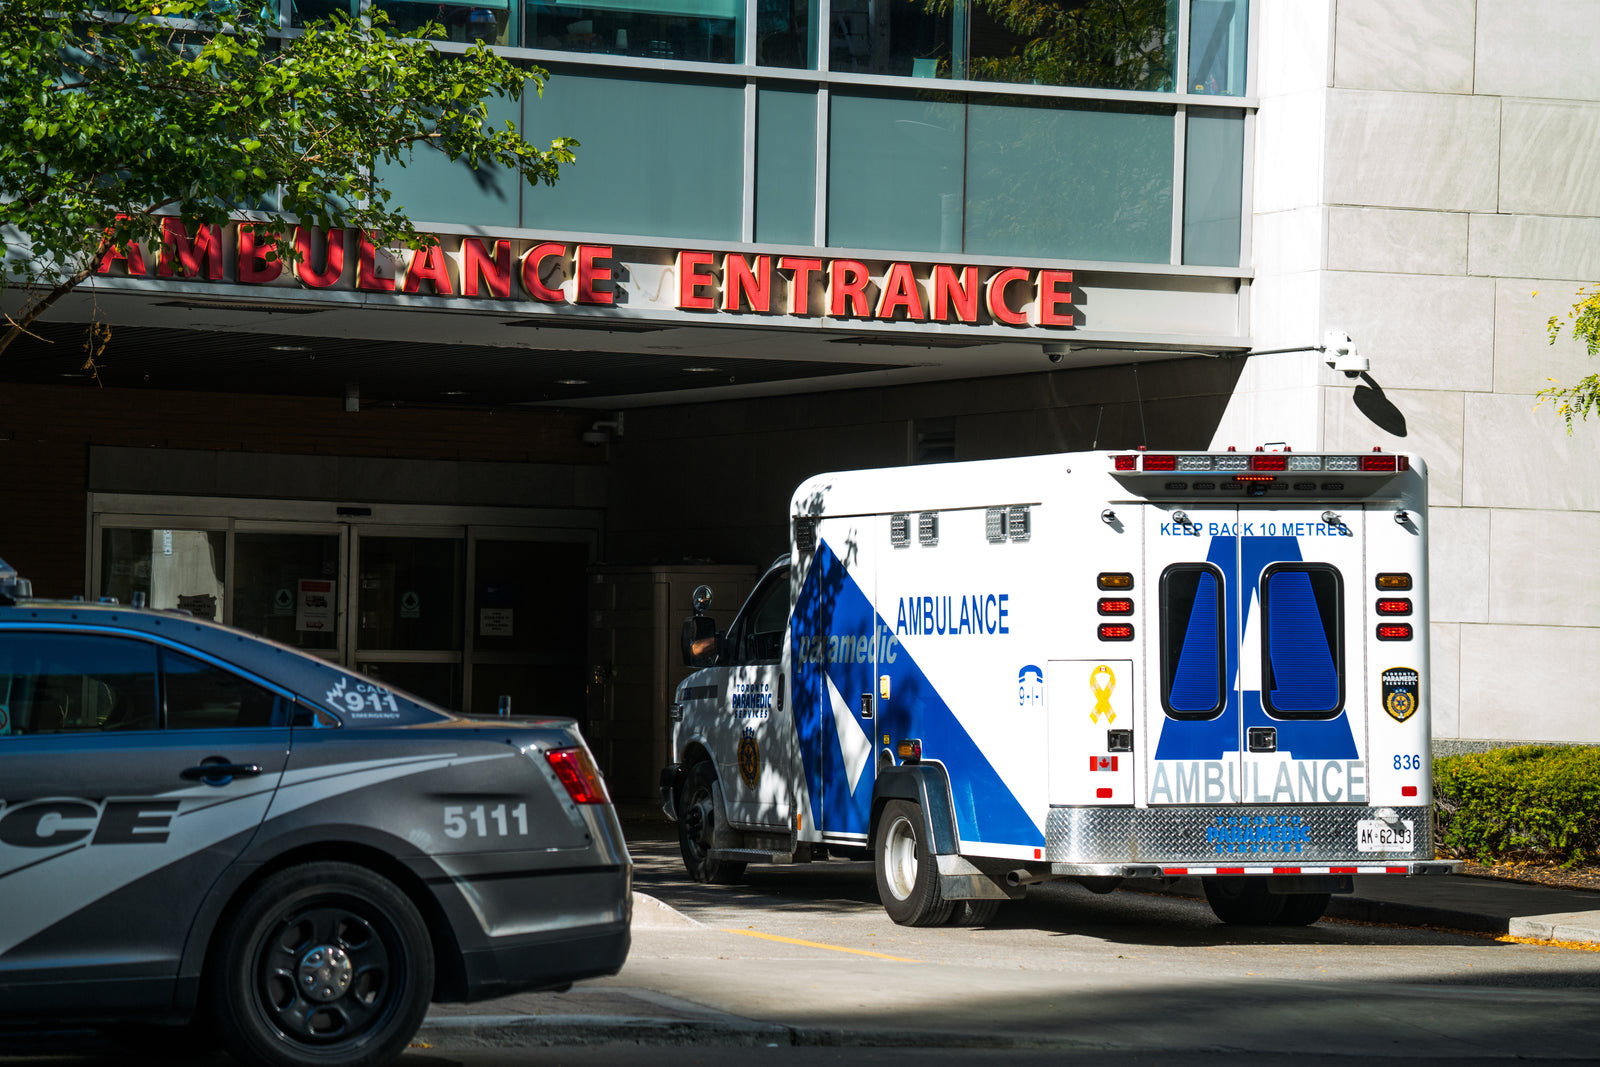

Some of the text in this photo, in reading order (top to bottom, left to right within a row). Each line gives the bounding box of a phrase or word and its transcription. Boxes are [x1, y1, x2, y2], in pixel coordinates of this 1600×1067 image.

[97, 212, 1074, 327] AMBULANCE ENTRANCE
[1160, 522, 1347, 536] KEEP BACK 10 METRES
[896, 593, 1009, 636] AMBULANCE
[797, 624, 898, 673] paramedic
[736, 683, 769, 692] TORONTO
[344, 691, 399, 712] 9-1-1
[731, 693, 772, 709] PARAMEDIC
[734, 709, 768, 719] SERVICES
[1393, 754, 1421, 770] 836
[1150, 760, 1366, 804] AMBULANCE
[443, 802, 528, 839] 5111
[1215, 815, 1301, 826] TORONTO
[1206, 825, 1311, 842] PARAMEDIC
[1361, 828, 1412, 845] AK 62193
[1215, 843, 1303, 854] SERVICES
